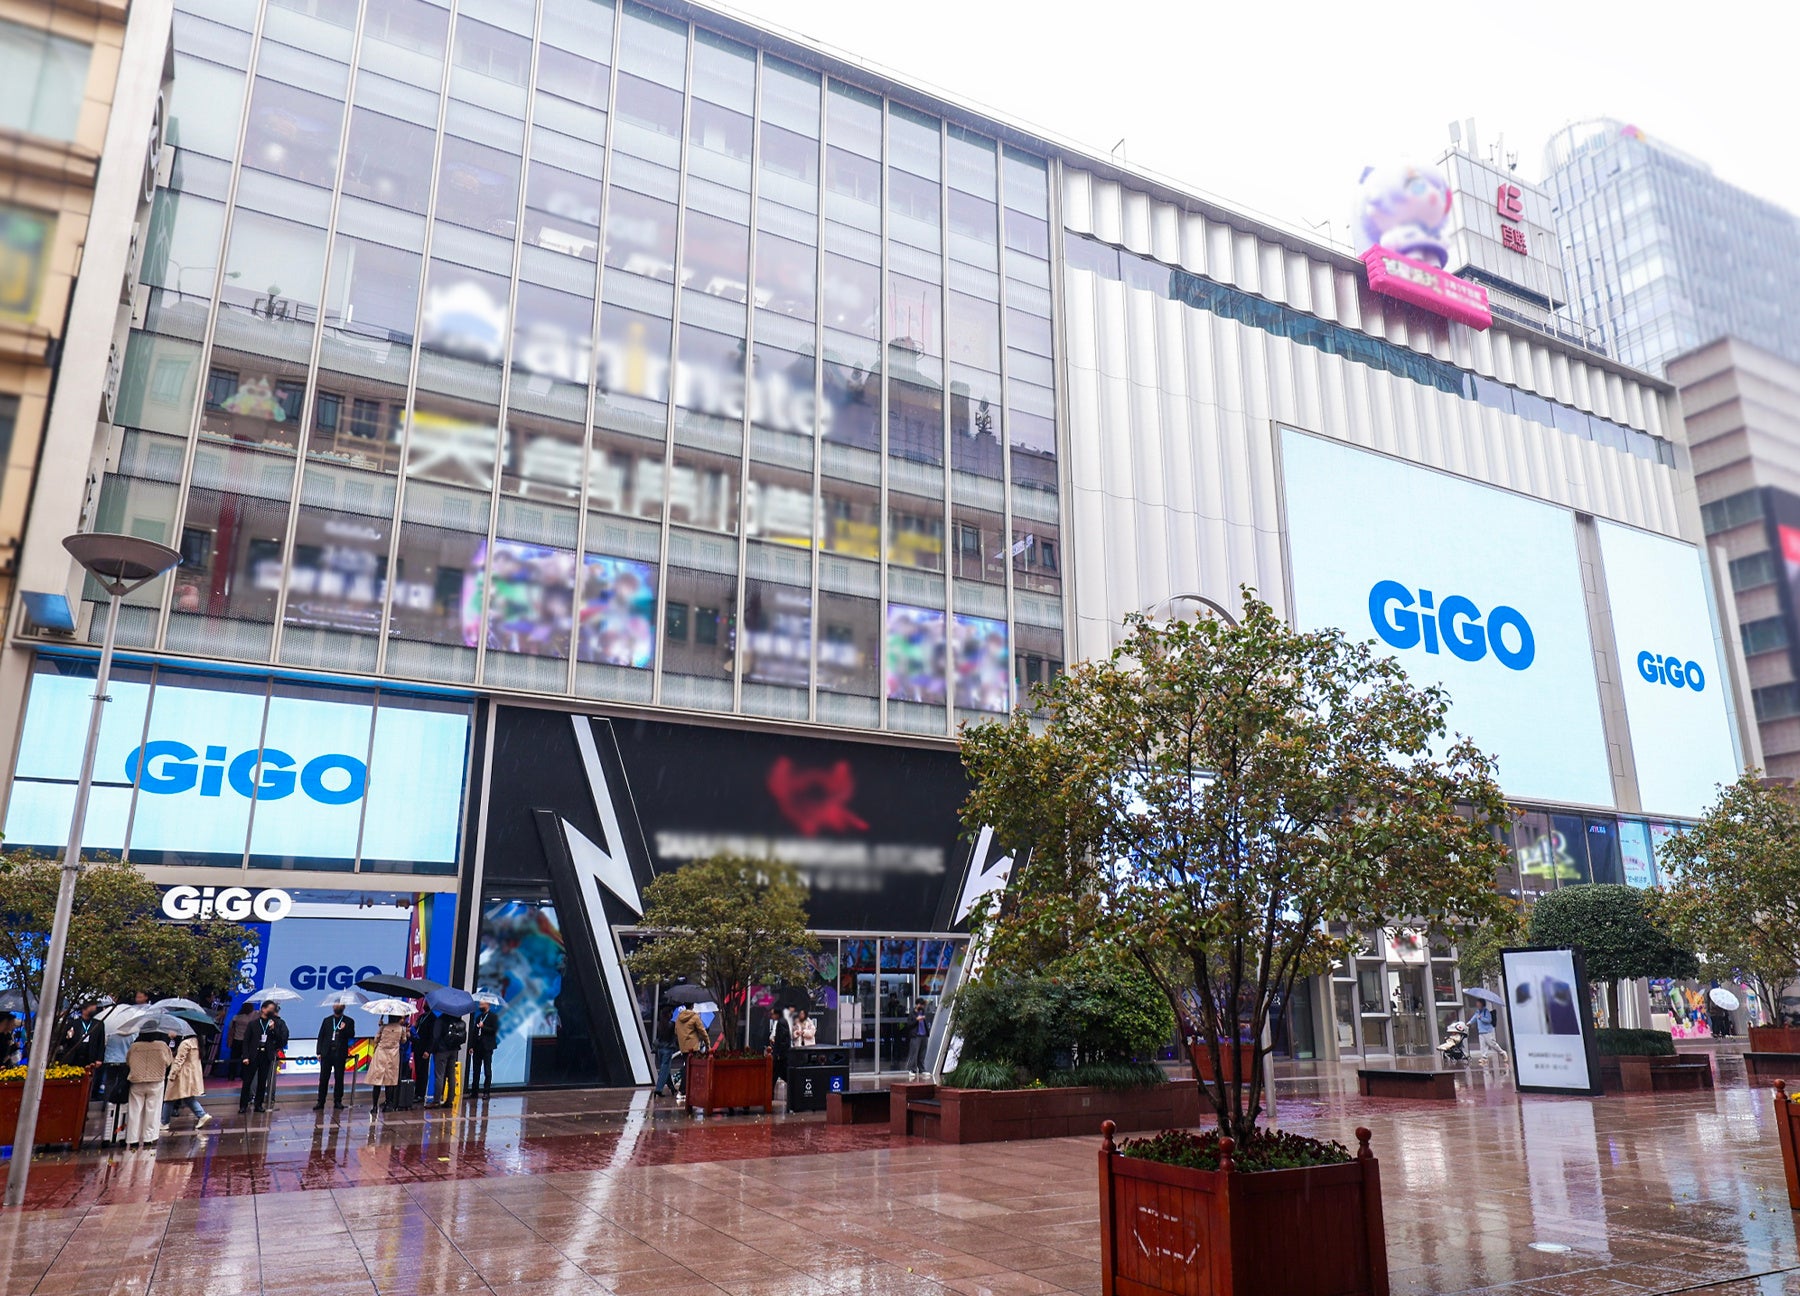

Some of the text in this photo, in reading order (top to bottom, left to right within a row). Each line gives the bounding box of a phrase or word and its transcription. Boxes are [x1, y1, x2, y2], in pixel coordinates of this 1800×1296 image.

[1368, 580, 1536, 671] GiGO
[1637, 650, 1705, 692] GiGO
[125, 740, 368, 804] GiGO
[162, 885, 292, 922] GiGO
